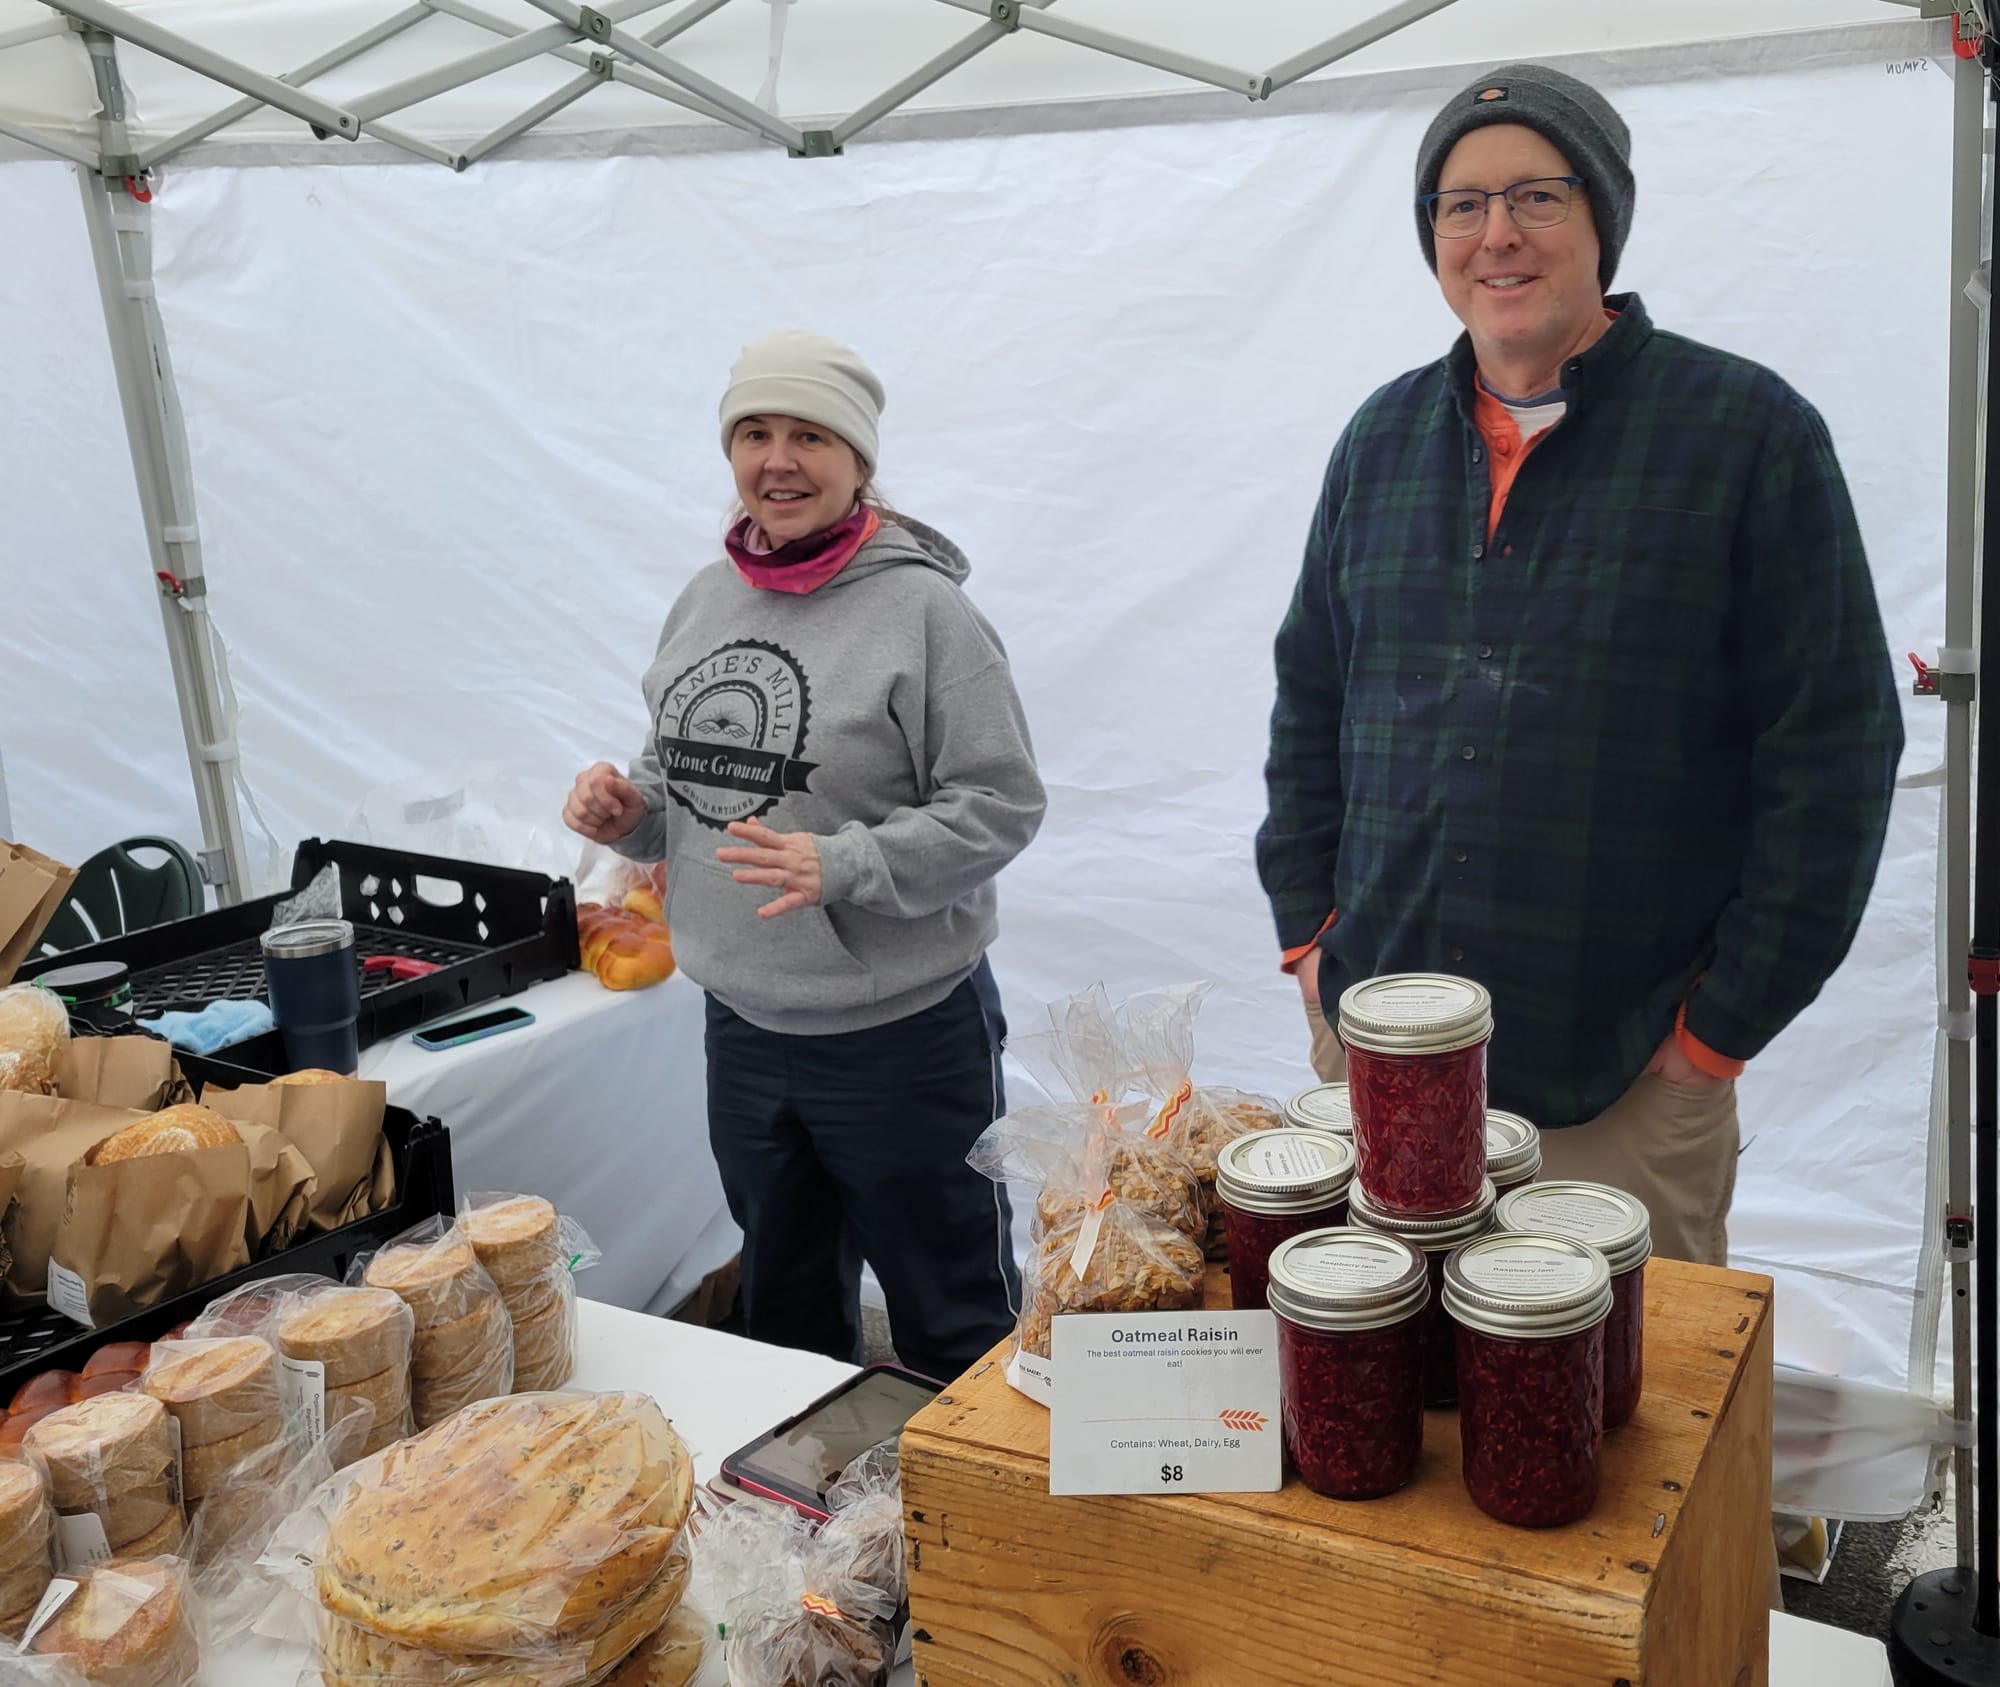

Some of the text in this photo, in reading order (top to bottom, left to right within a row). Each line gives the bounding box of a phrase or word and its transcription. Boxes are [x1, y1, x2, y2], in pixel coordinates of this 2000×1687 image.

[666, 655, 793, 739] JANIE'S MILL
[665, 747, 777, 784] Stone Ground
[711, 798, 755, 816] ARTISANS
[1111, 1327, 1239, 1343] Oatmeal Raisin
[1087, 1350, 1102, 1358] The
[1122, 1349, 1156, 1357] oatmeal
[1157, 1348, 1179, 1356] raisin
[1180, 1348, 1212, 1356] cookies
[1214, 1349, 1228, 1358] you
[1229, 1347, 1244, 1355] will
[1245, 1347, 1263, 1355] ever
[1167, 1360, 1183, 1368] eat!
[1110, 1437, 1241, 1450] Contains: Wheat, Dairy, Egg
[1160, 1464, 1184, 1485] $8
